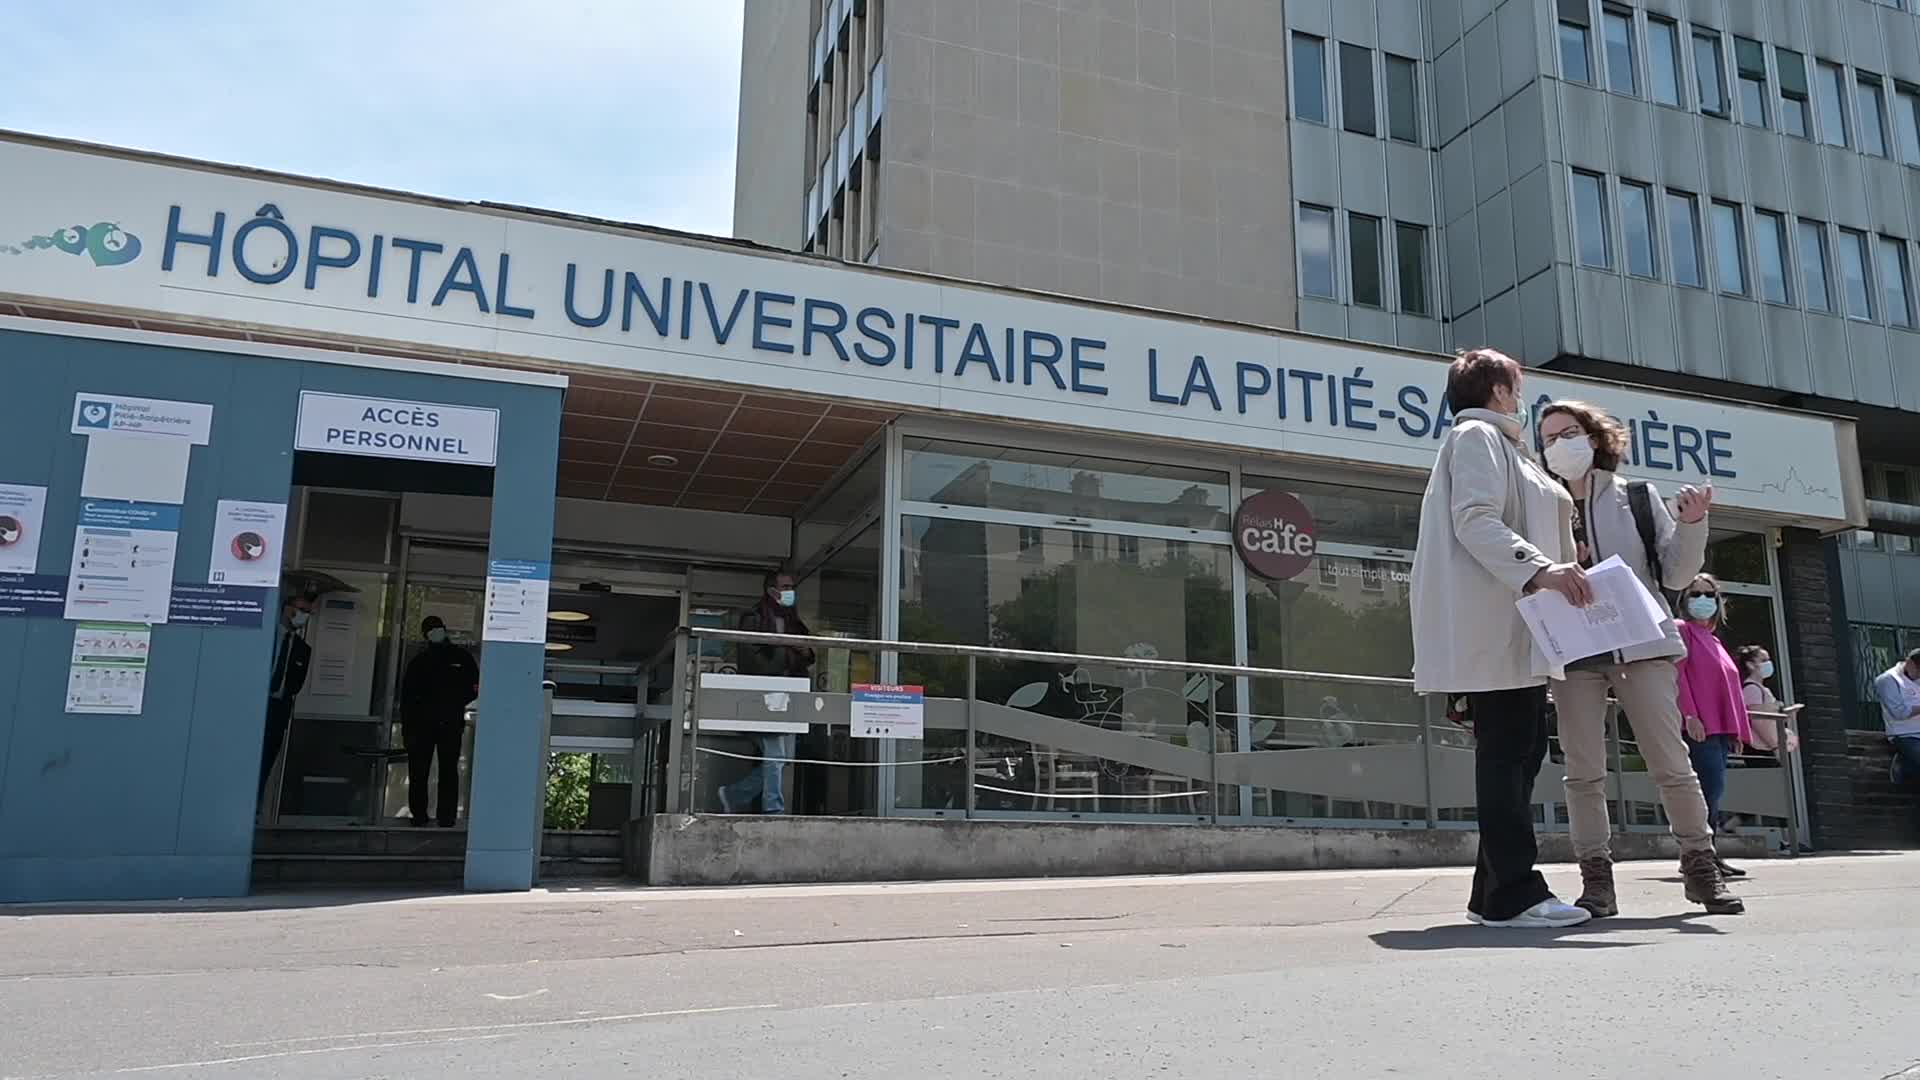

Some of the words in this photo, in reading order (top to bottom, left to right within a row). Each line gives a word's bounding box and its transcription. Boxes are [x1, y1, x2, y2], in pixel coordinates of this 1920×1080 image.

[161, 203, 535, 319] HÔPITAL
[563, 263, 1109, 396] UNIVERSITAIRE
[1148, 348, 1222, 411] LA
[361, 406, 439, 428] ACCÈS
[326, 427, 470, 455] PERSONNEL
[1241, 523, 1314, 558] cafe
